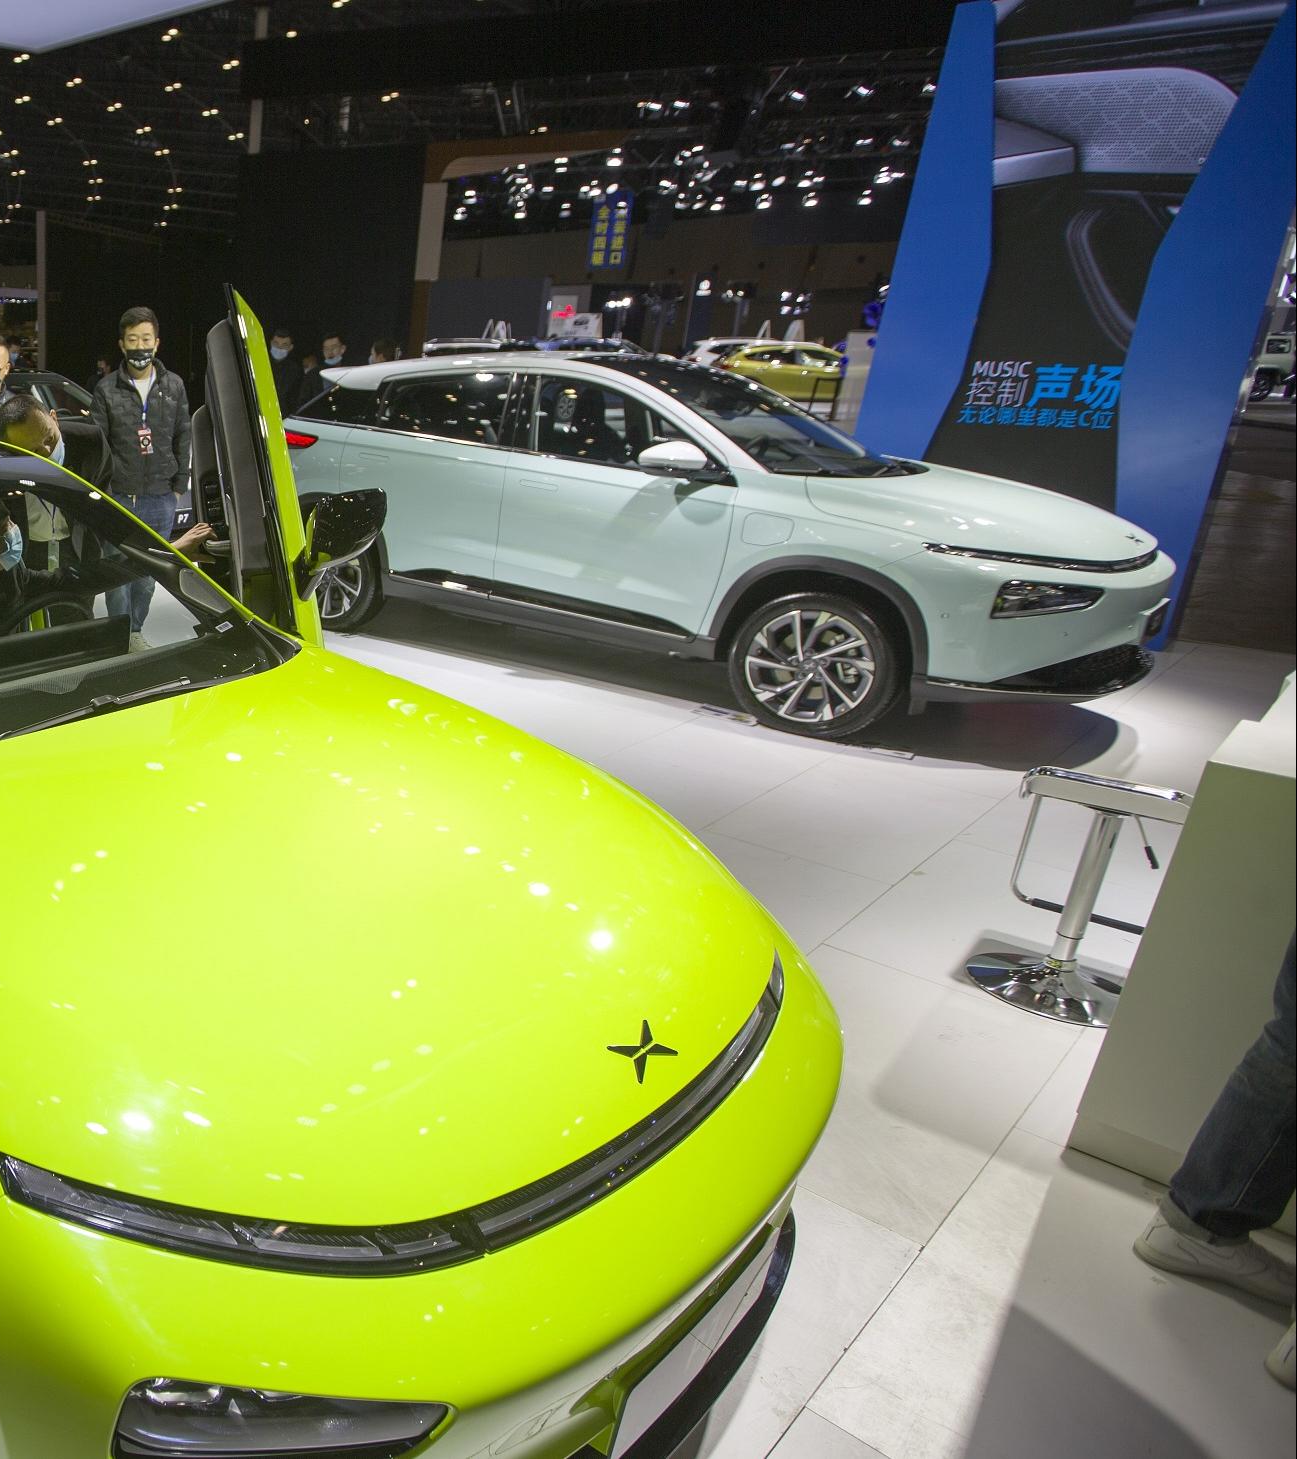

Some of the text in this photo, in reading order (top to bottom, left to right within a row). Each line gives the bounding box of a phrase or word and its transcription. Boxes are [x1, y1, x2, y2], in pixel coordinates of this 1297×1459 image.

[972, 361, 1032, 378] MUSIC
[964, 363, 1124, 410] 控制 声场
[957, 407, 1115, 429] 无论哪里都是C位
[177, 513, 189, 524] P7
